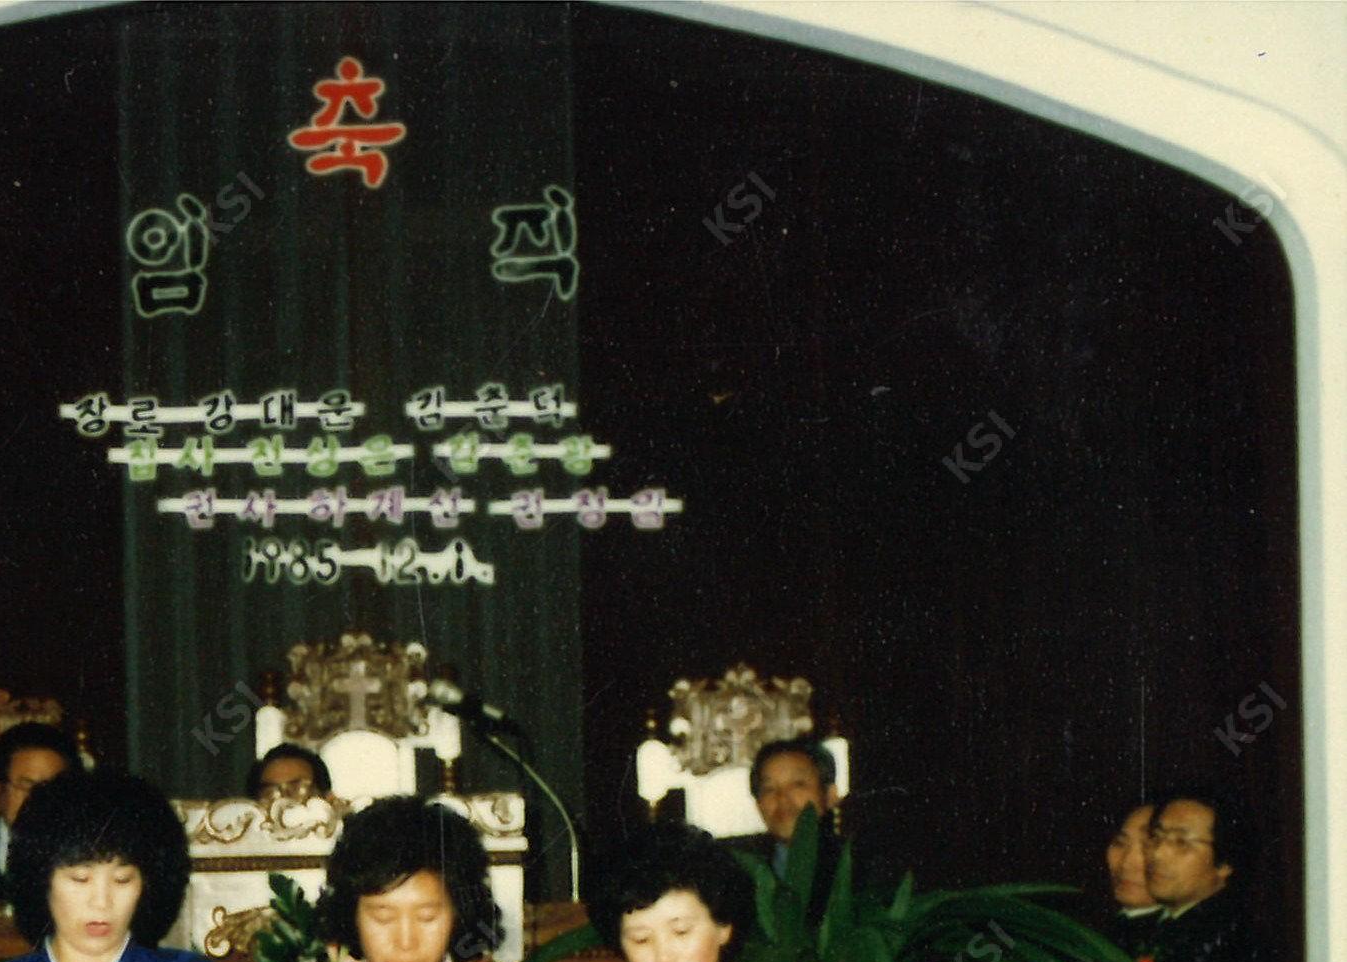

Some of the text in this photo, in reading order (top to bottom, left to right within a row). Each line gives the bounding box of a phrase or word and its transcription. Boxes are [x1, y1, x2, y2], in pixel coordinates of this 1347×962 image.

[288, 55, 406, 188] 축
[126, 184, 580, 318] 임 직
[72, 391, 164, 439] 장로
[199, 388, 356, 436] 강대운
